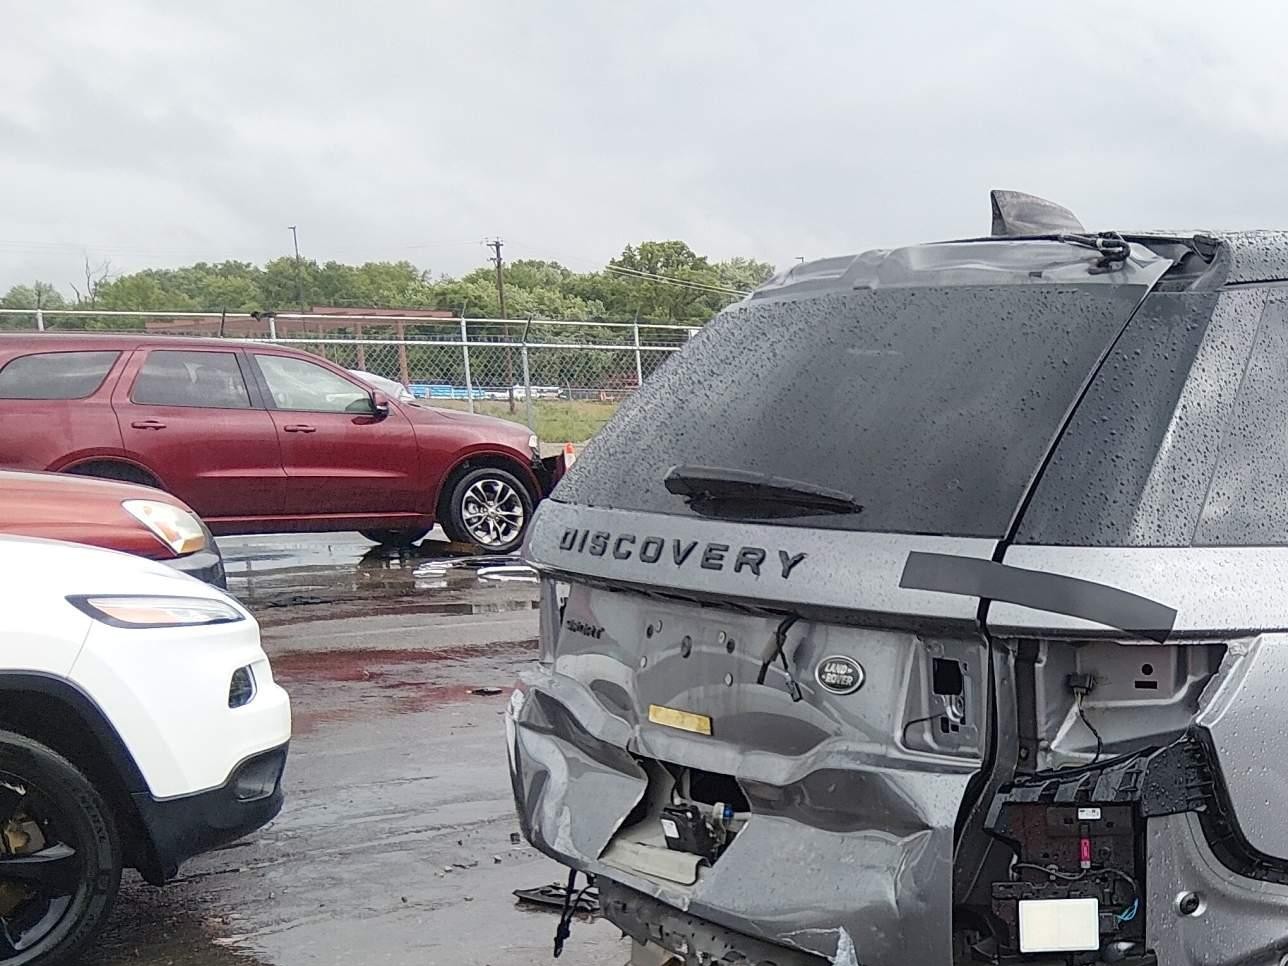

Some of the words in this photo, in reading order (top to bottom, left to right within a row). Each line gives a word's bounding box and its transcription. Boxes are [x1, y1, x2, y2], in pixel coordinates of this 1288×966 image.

[559, 528, 807, 579] DISCOVERY
[824, 663, 848, 674] LAND
[825, 673, 854, 686] ROVER
